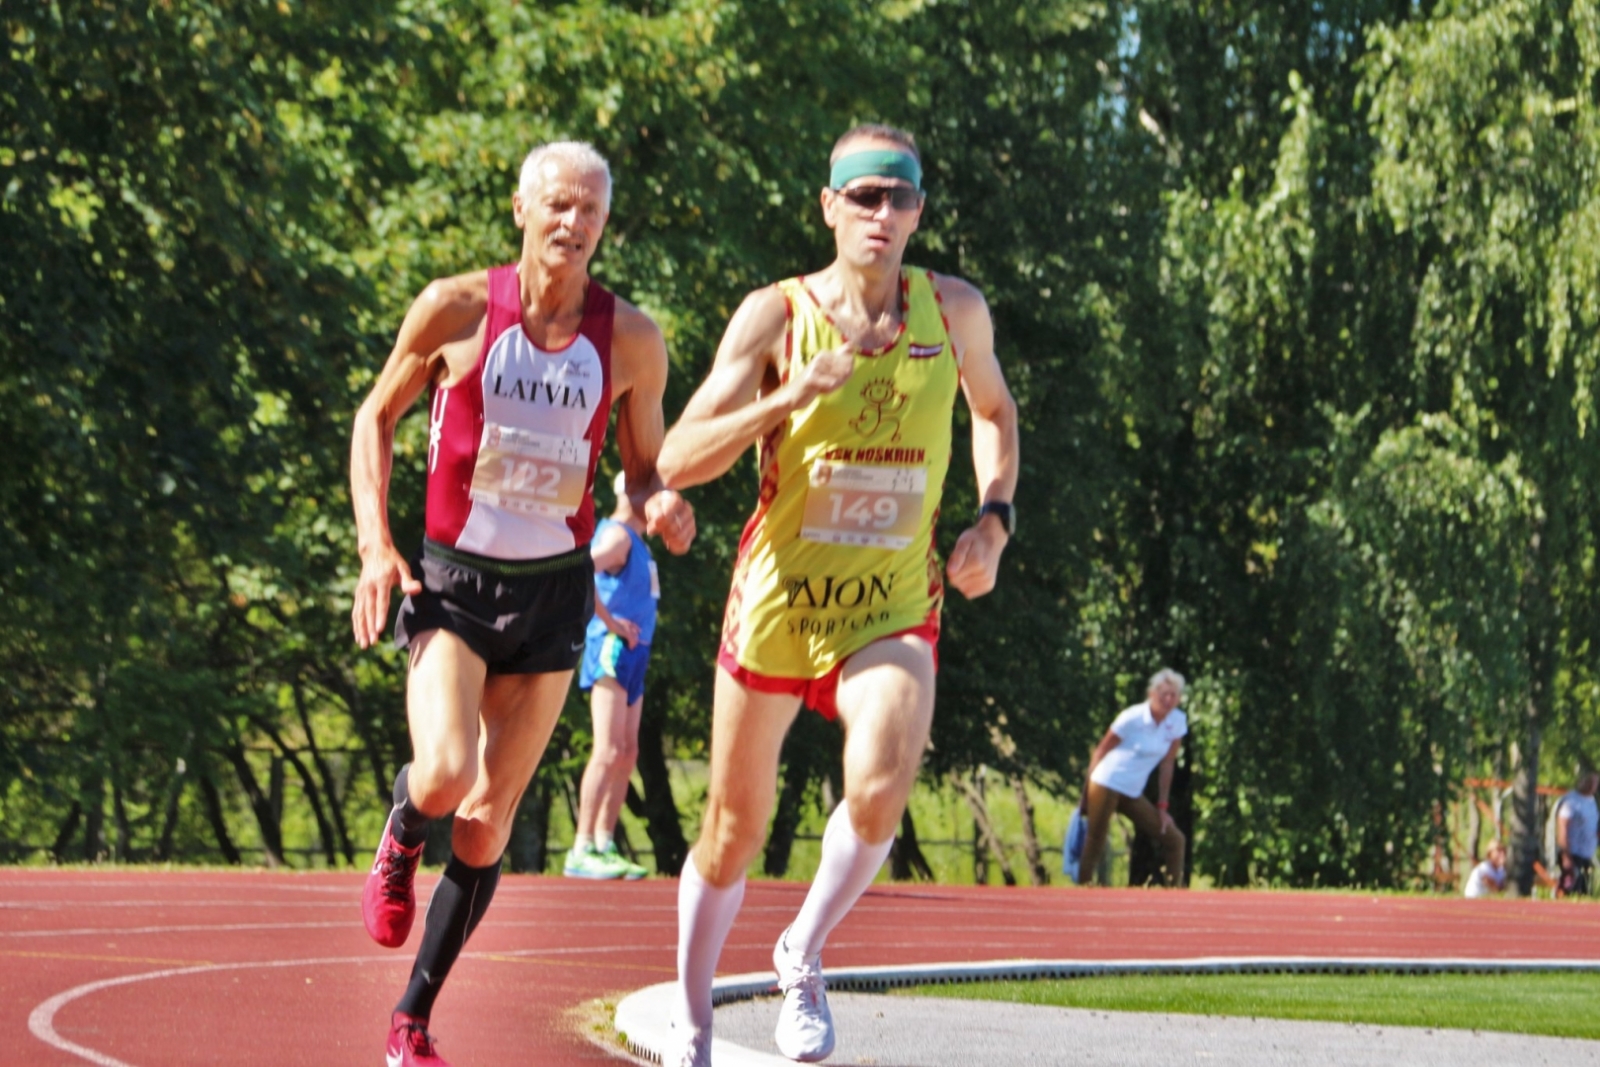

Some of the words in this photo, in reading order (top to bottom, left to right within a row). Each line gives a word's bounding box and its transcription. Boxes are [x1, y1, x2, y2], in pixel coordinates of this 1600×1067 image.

[493, 374, 588, 410] LATVIA
[501, 458, 562, 499] 122
[829, 493, 899, 529] 149
